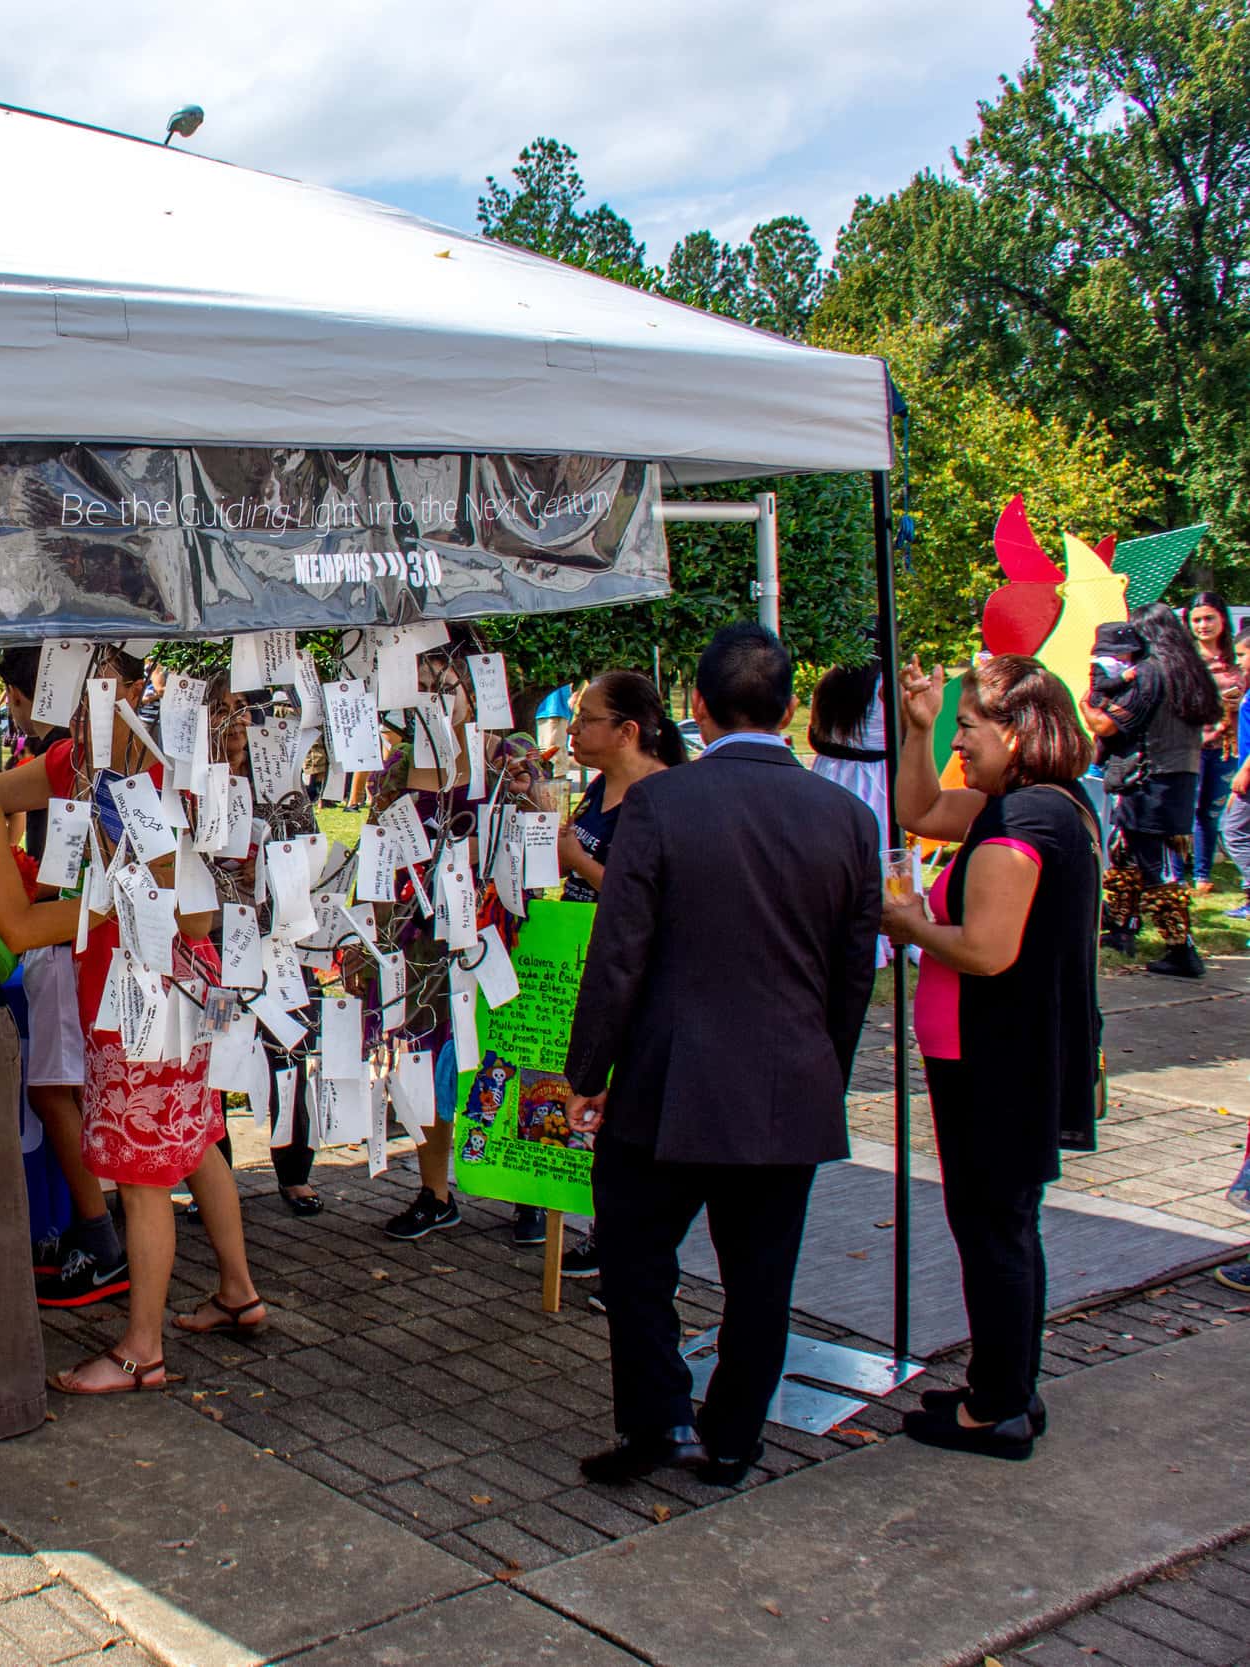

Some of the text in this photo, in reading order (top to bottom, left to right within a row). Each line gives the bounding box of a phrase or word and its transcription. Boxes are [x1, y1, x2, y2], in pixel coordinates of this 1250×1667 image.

[61, 493, 107, 527] Be
[119, 492, 173, 527] the
[179, 493, 291, 537] Guiding
[297, 495, 359, 537] Light
[421, 492, 458, 524] the
[466, 492, 520, 522] Next
[528, 489, 614, 522] Century
[294, 549, 442, 589] MEMPHIS 3.0
